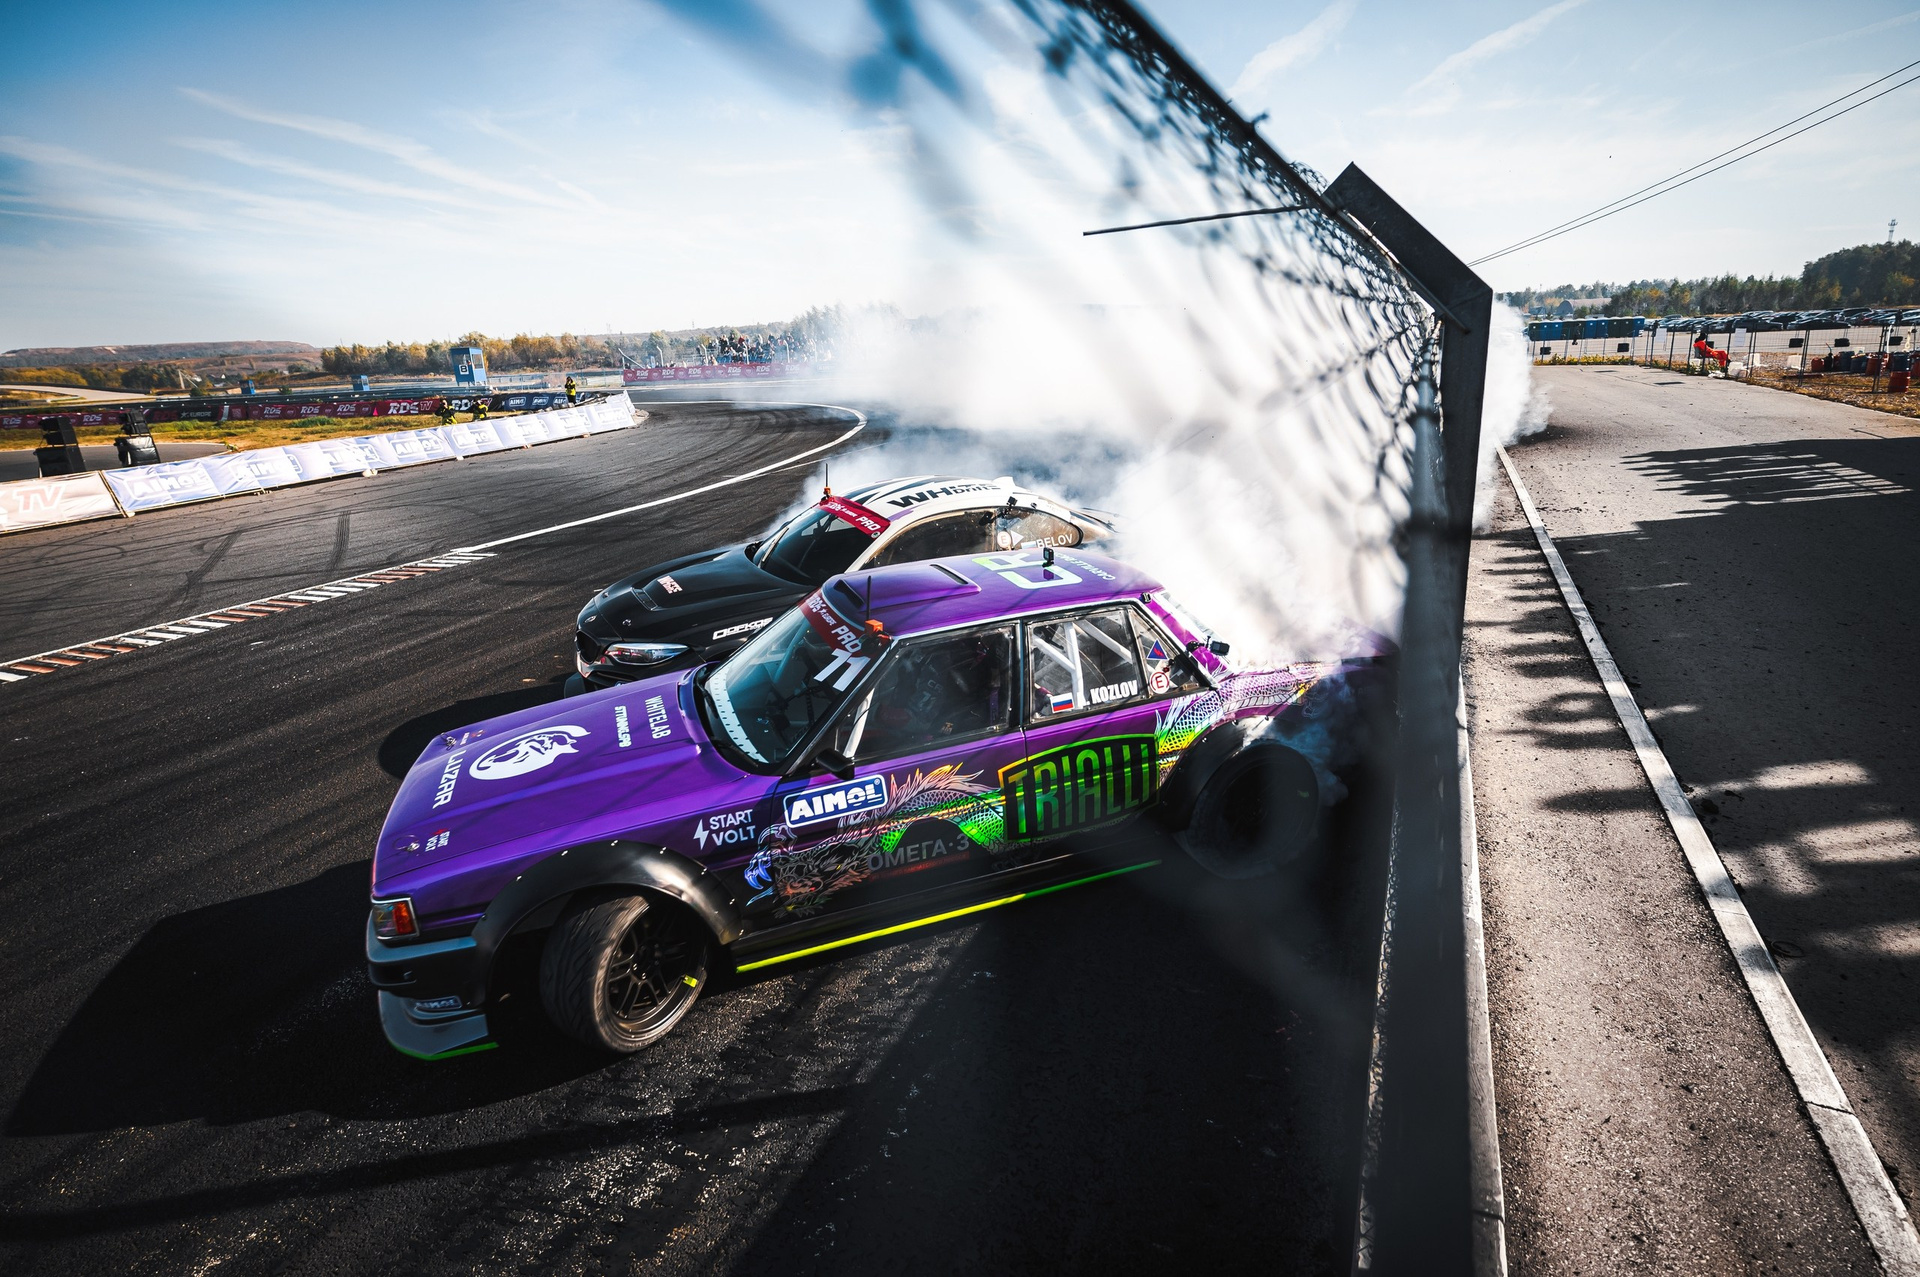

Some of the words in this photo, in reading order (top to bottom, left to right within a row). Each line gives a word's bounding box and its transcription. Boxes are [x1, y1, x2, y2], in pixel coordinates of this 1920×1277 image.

[264, 406, 281, 415] RDS
[301, 406, 320, 414] RDS
[337, 404, 356, 412] RDS
[388, 402, 419, 414] RDS
[451, 399, 476, 411] RD
[2, 417, 22, 425] RDS
[83, 414, 103, 422] RDS
[15, 485, 63, 513] TV
[855, 516, 881, 531] PRO
[1036, 534, 1073, 548] BELOV
[831, 625, 862, 653] PRO
[813, 648, 871, 692] 11
[1090, 680, 1138, 704] KOZLOV
[644, 695, 671, 739] WHITELAB
[432, 750, 466, 809] LUZAR
[1008, 743, 1150, 834] TRIALLI
[790, 783, 883, 821] AIMOL
[709, 809, 753, 830] START
[712, 825, 756, 846] VOLT
